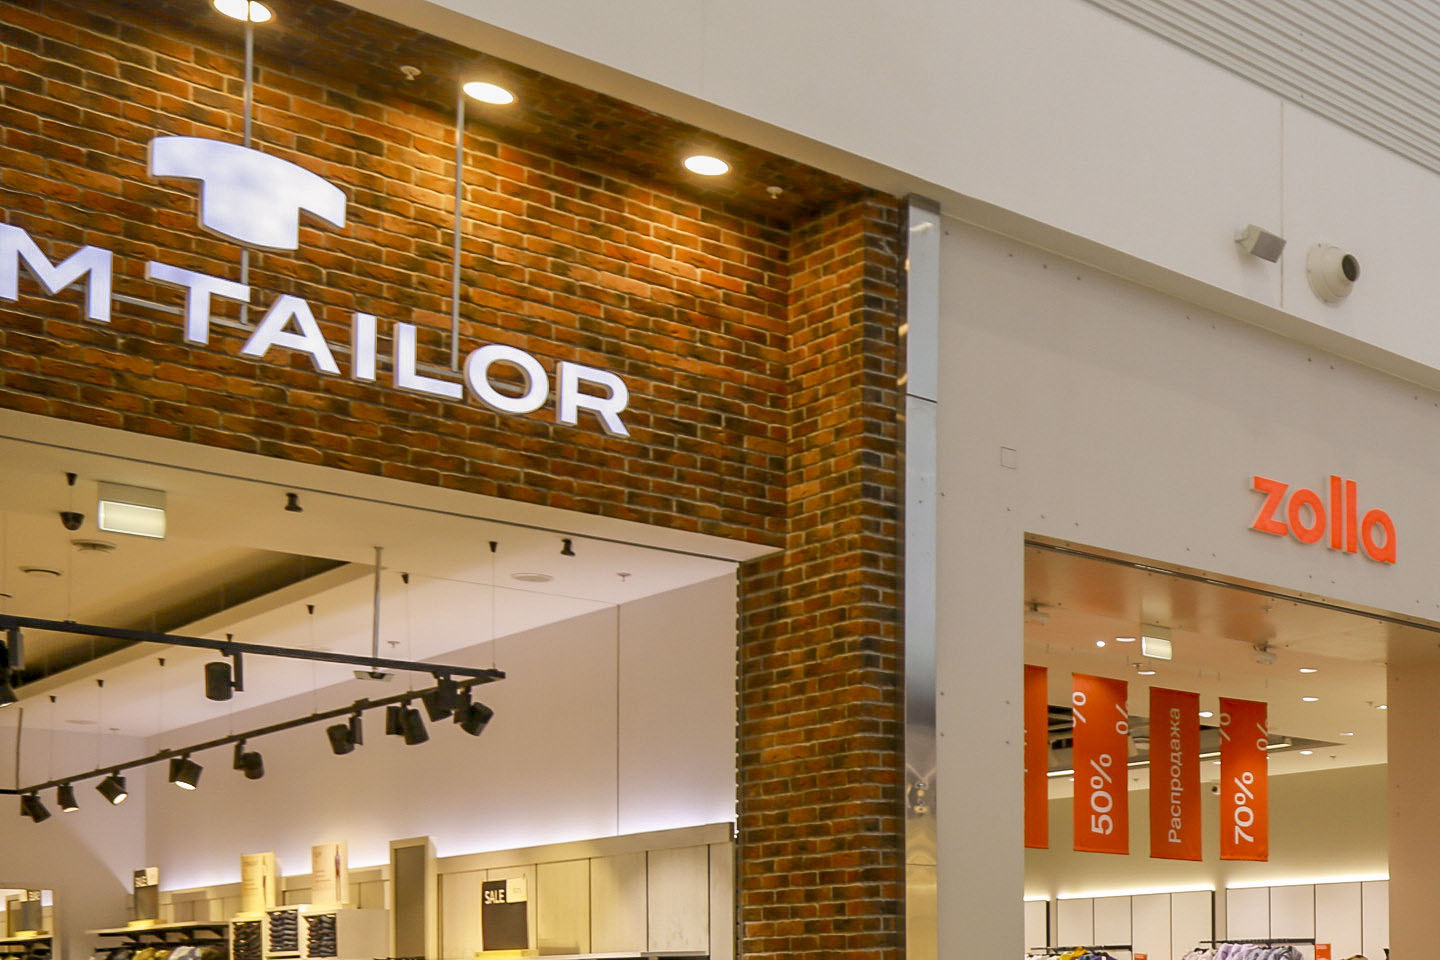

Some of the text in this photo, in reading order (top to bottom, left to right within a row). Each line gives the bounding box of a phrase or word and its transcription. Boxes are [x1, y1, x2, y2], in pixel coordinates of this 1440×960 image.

[145, 261, 629, 437] TAILOR
[1249, 474, 1397, 565] zolla
[1090, 753, 1113, 836] 50%
[1168, 707, 1184, 844] Распродажа
[1234, 771, 1254, 845] 70%
[484, 889, 505, 905] SALE
